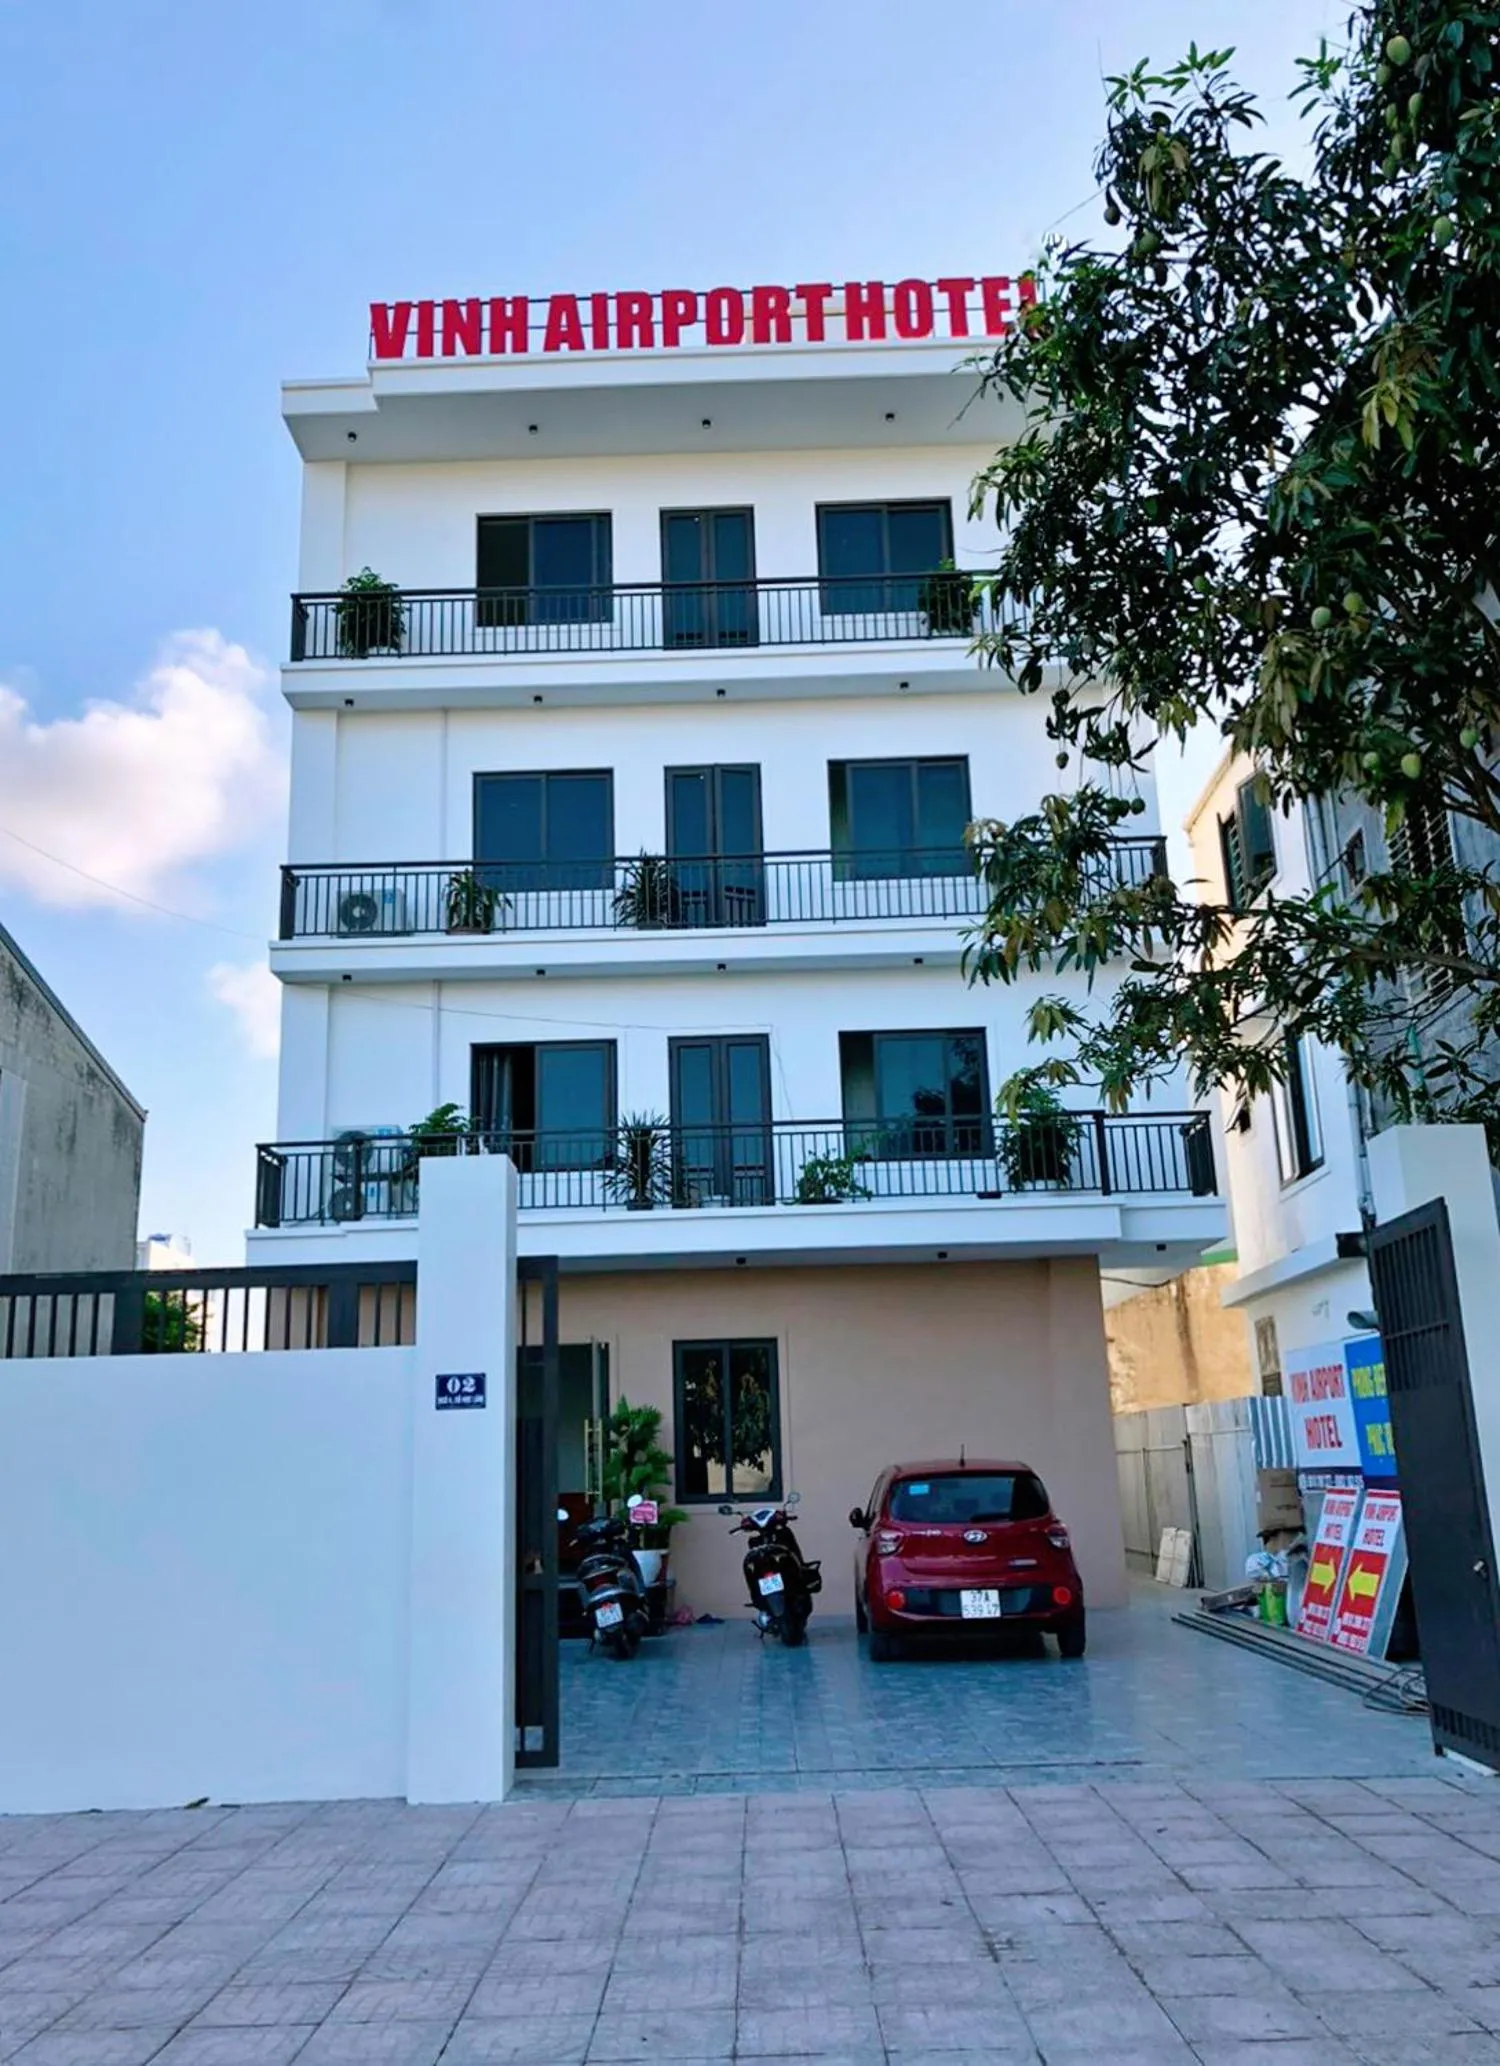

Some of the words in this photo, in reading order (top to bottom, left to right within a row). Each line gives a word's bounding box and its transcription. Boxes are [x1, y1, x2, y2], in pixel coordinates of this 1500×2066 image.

[370, 296, 530, 360] VINH
[543, 283, 833, 353] AIRPORT
[447, 1376, 476, 1393] 02
[1304, 1414, 1343, 1450] HOTEL
